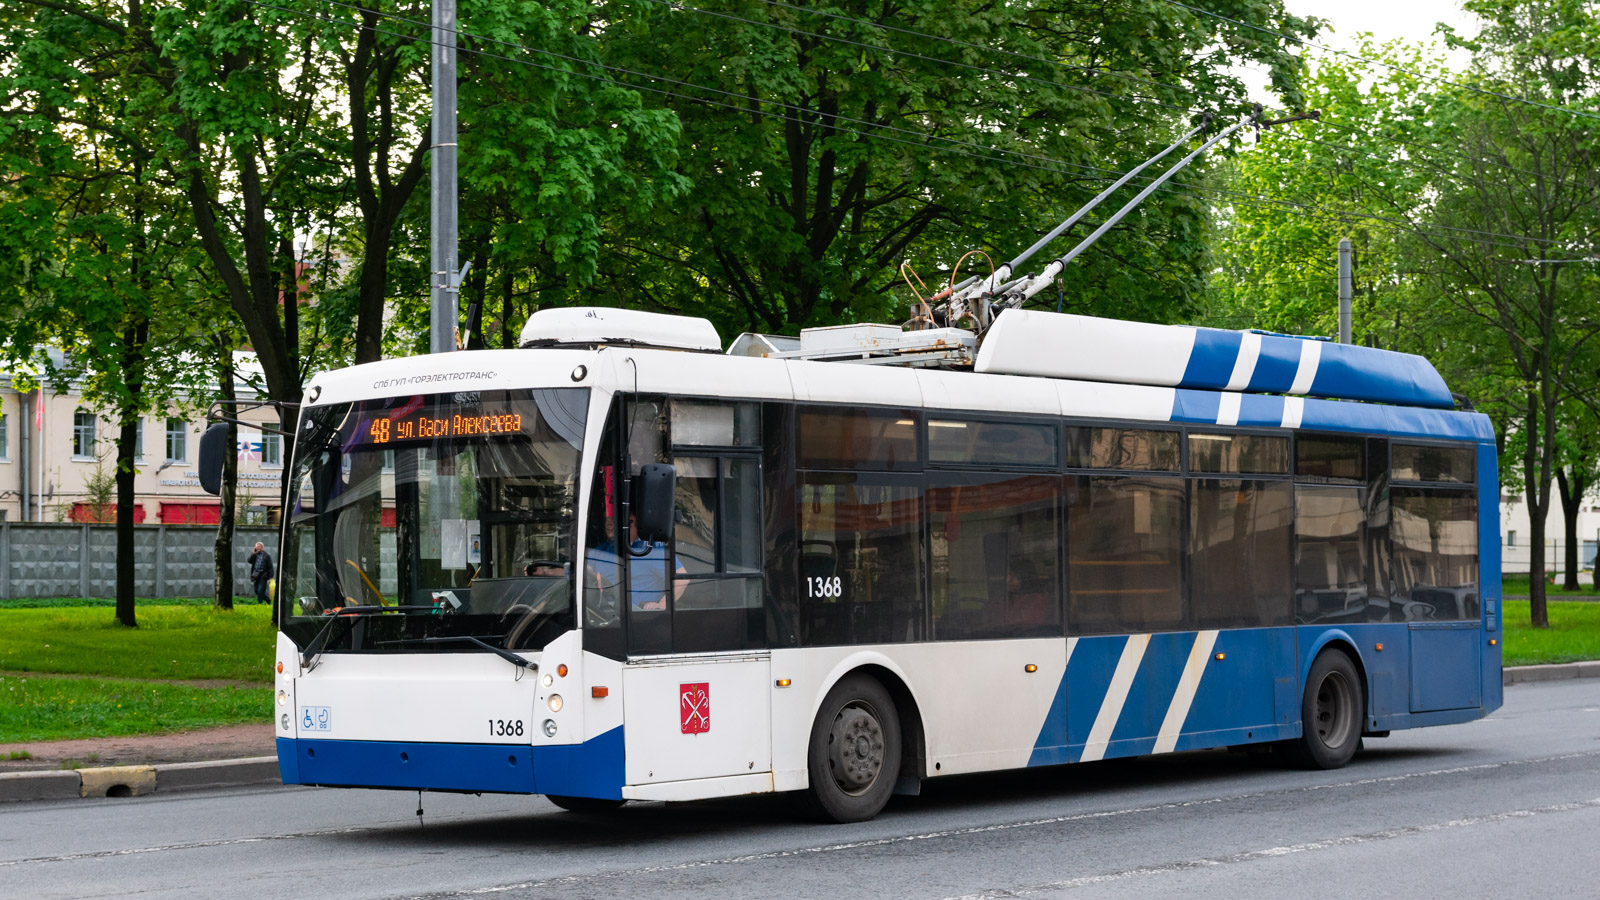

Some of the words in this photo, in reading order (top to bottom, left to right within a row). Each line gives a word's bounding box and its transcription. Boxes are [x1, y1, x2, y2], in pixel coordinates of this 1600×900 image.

[390, 377, 406, 387] ГУП
[407, 371, 498, 384] «ГОРЭЛЕКТРОТРАНС»
[370, 418, 391, 444] 48
[397, 421, 416, 439] ул.
[418, 417, 449, 438] Васи
[453, 414, 521, 435] Алексеева
[806, 576, 842, 598] 1368
[488, 719, 524, 736] 1368
